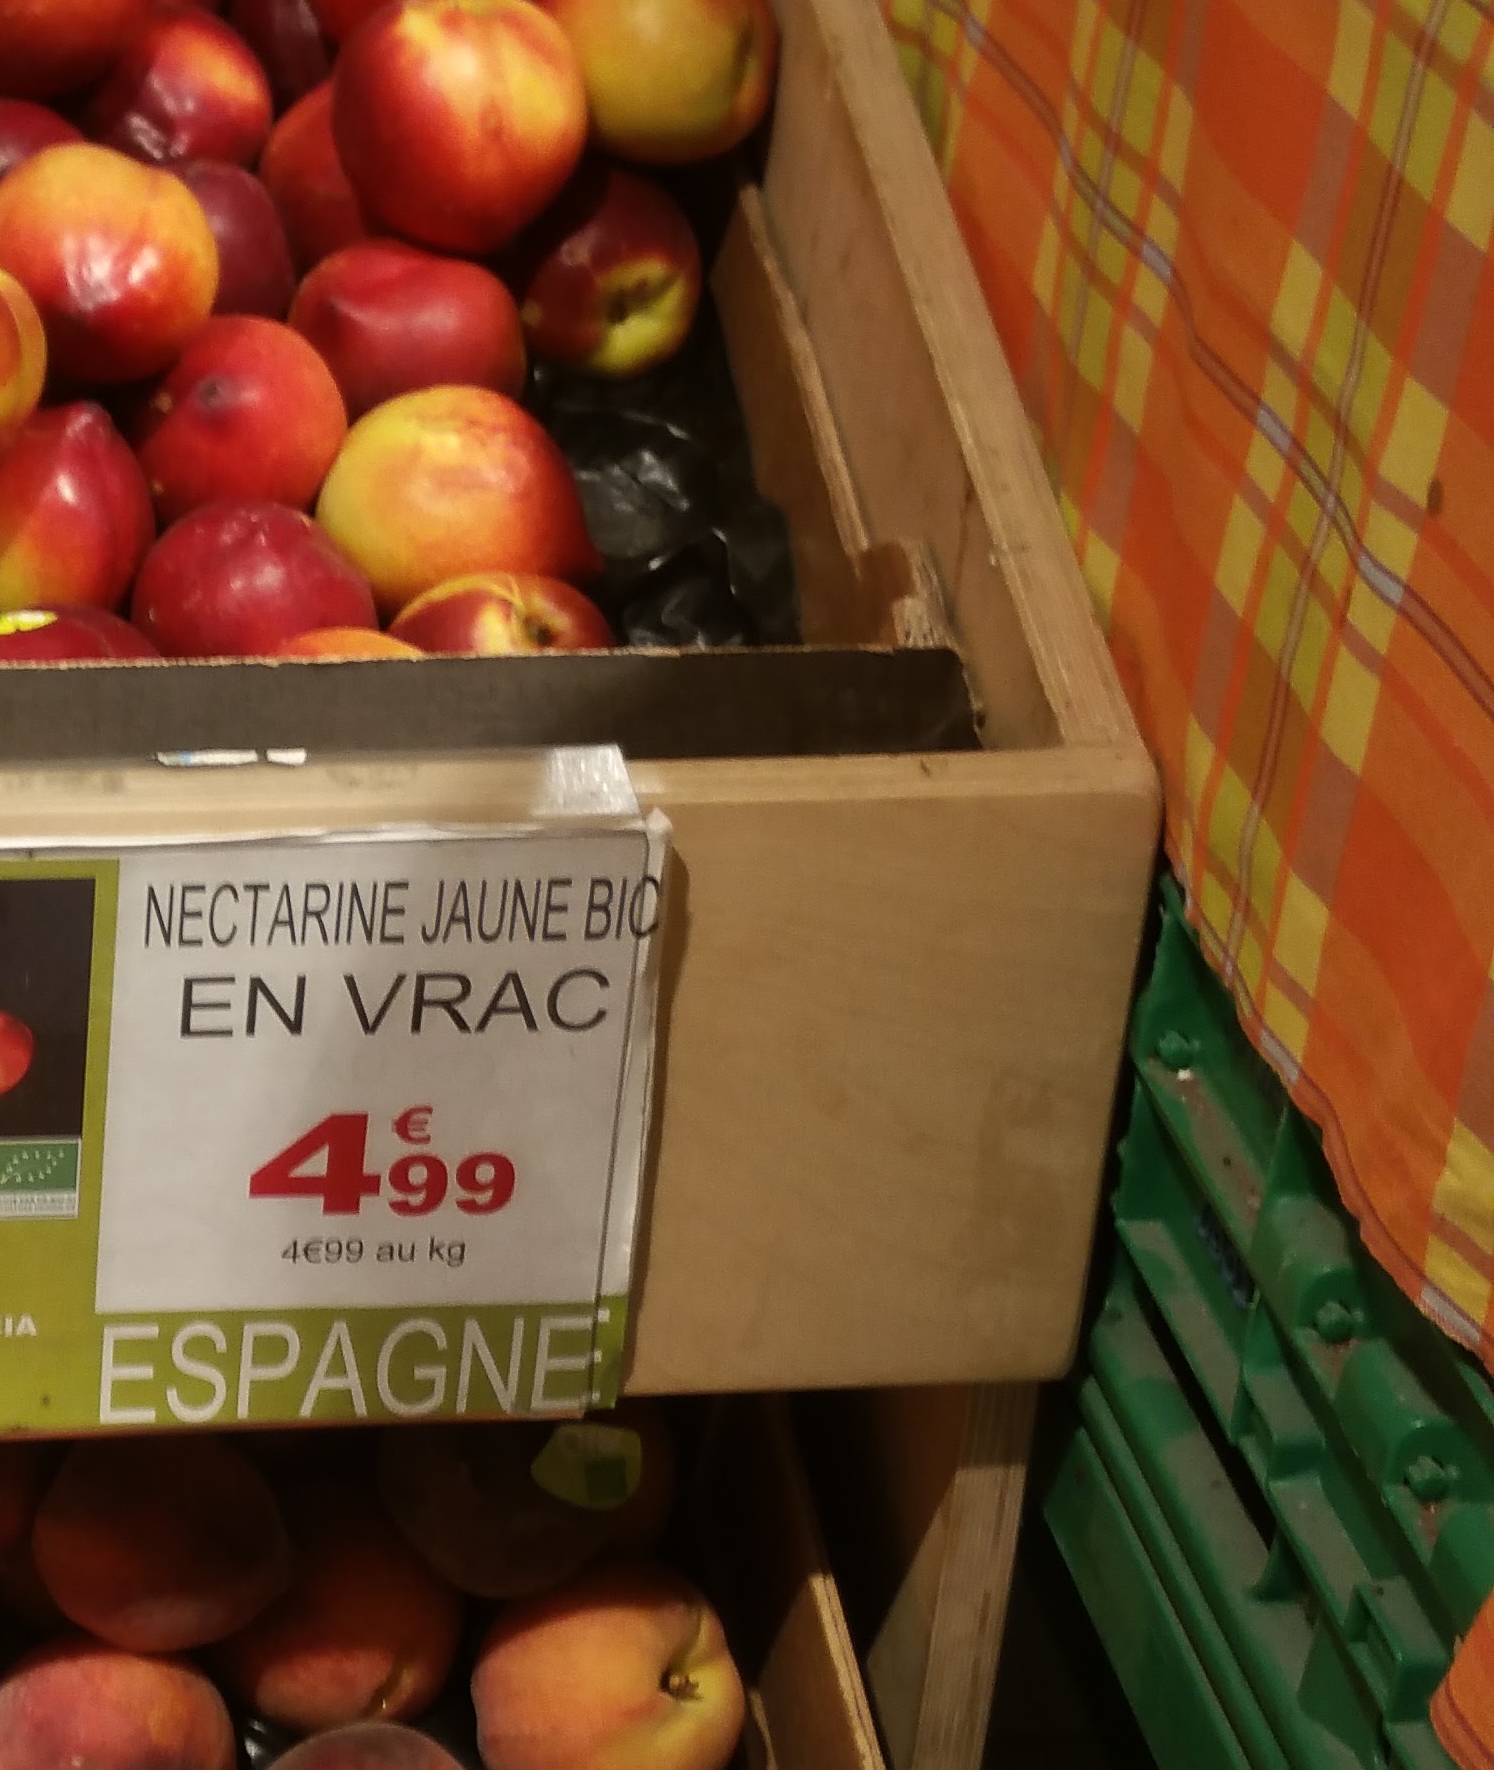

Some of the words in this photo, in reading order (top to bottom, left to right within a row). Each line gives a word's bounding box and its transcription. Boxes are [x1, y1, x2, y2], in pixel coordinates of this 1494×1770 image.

[144, 879, 409, 949] NECTARINE
[421, 877, 573, 944] JAUNE
[583, 874, 661, 942] BIO
[179, 974, 306, 1038] EN
[343, 966, 611, 1036] VRAC
[281, 1237, 364, 1265] 4€99
[377, 1242, 415, 1264] au
[428, 1236, 466, 1268] kg
[99, 1309, 610, 1425] ESPAGNE
